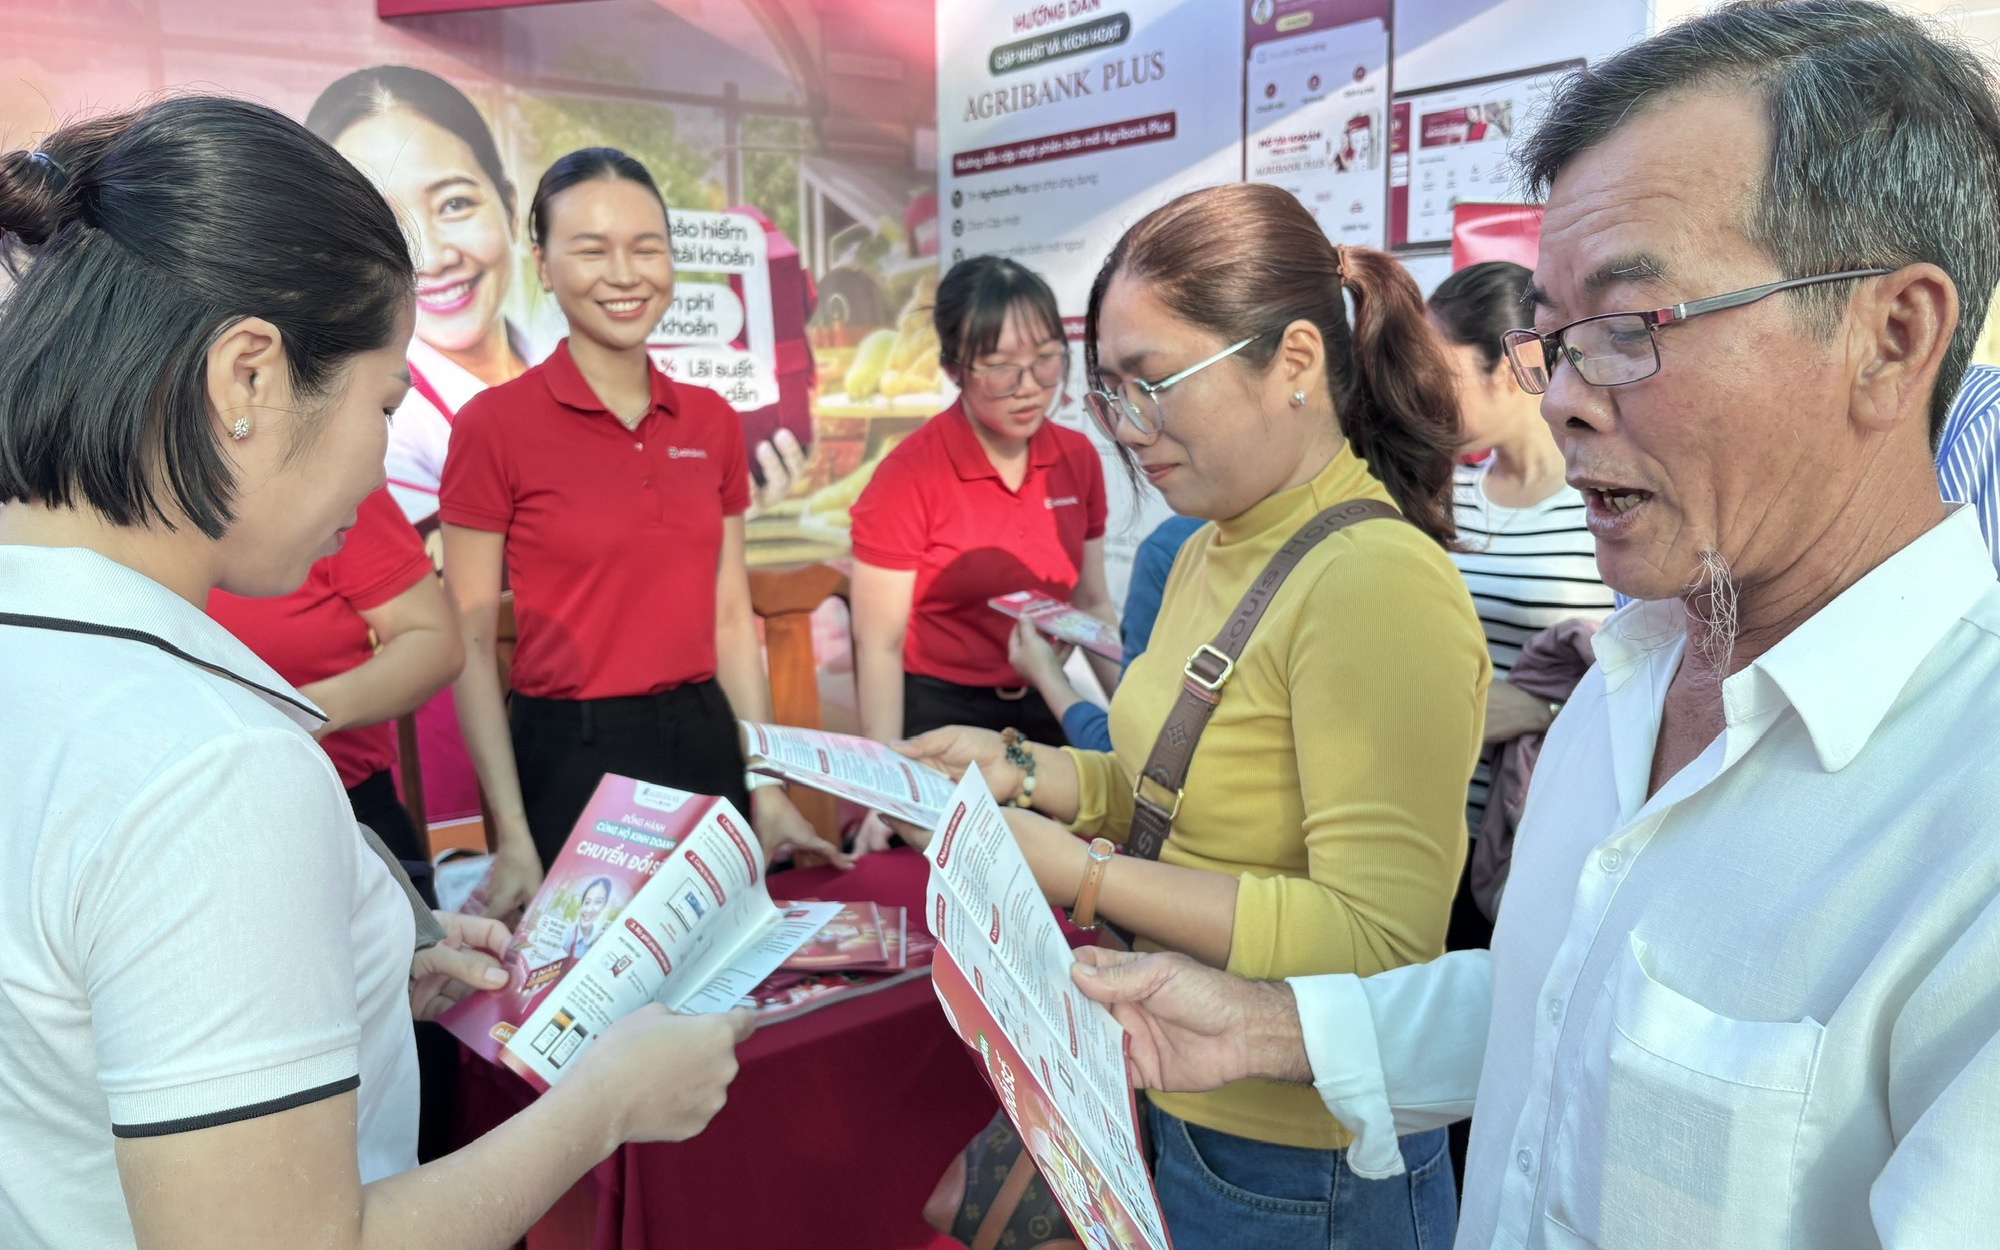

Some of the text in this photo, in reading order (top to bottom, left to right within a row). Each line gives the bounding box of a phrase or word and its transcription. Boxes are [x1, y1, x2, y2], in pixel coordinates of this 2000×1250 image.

[963, 50, 1166, 122] AGRIBANK PLUS
[701, 216, 748, 241] hiểm
[699, 244, 755, 267] khoản
[686, 292, 715, 316] phí
[661, 316, 718, 337] khoản
[689, 358, 712, 377] Lãi
[715, 357, 755, 378] suất
[596, 821, 618, 836] CÙNG
[618, 827, 631, 840] HỘ
[630, 831, 651, 844] KINH
[576, 840, 629, 867] CHUYỂN
[627, 852, 654, 873] ĐỔI
